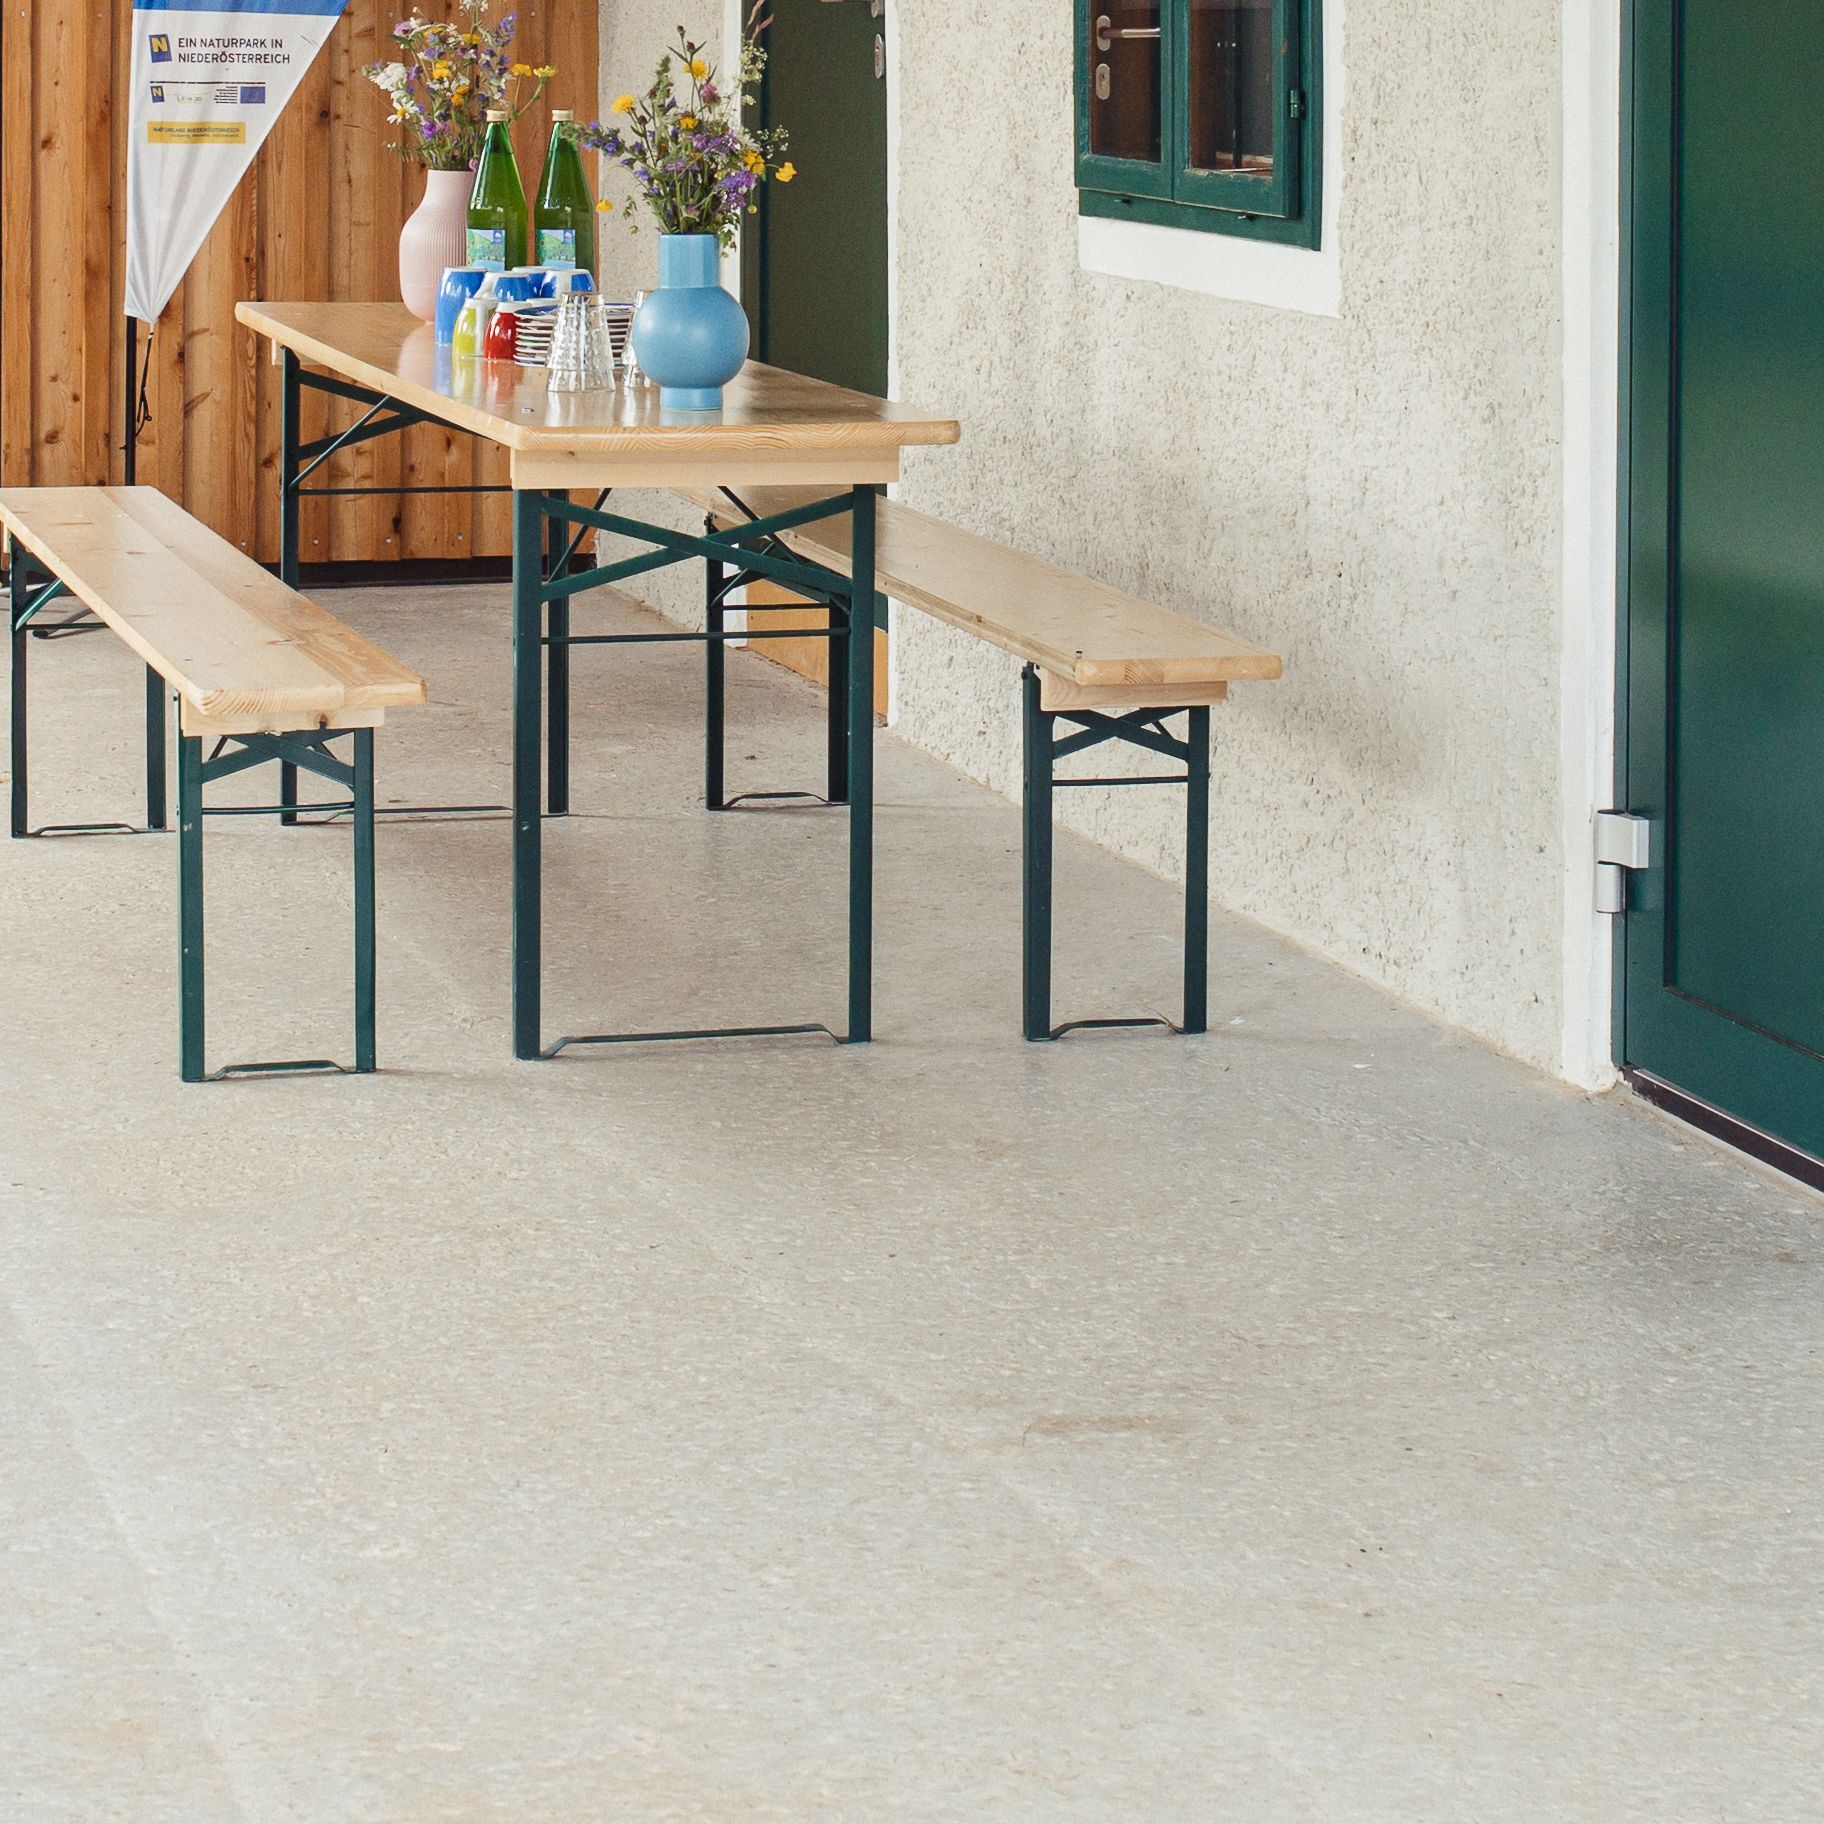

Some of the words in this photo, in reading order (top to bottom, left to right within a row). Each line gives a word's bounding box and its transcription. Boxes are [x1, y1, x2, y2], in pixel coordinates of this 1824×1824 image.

[152, 37, 168, 53] N
[178, 38, 197, 48] EIN
[200, 38, 267, 49] NATURPARK
[271, 38, 283, 49] IN
[178, 51, 290, 64] NIEDERÖSTERREICH
